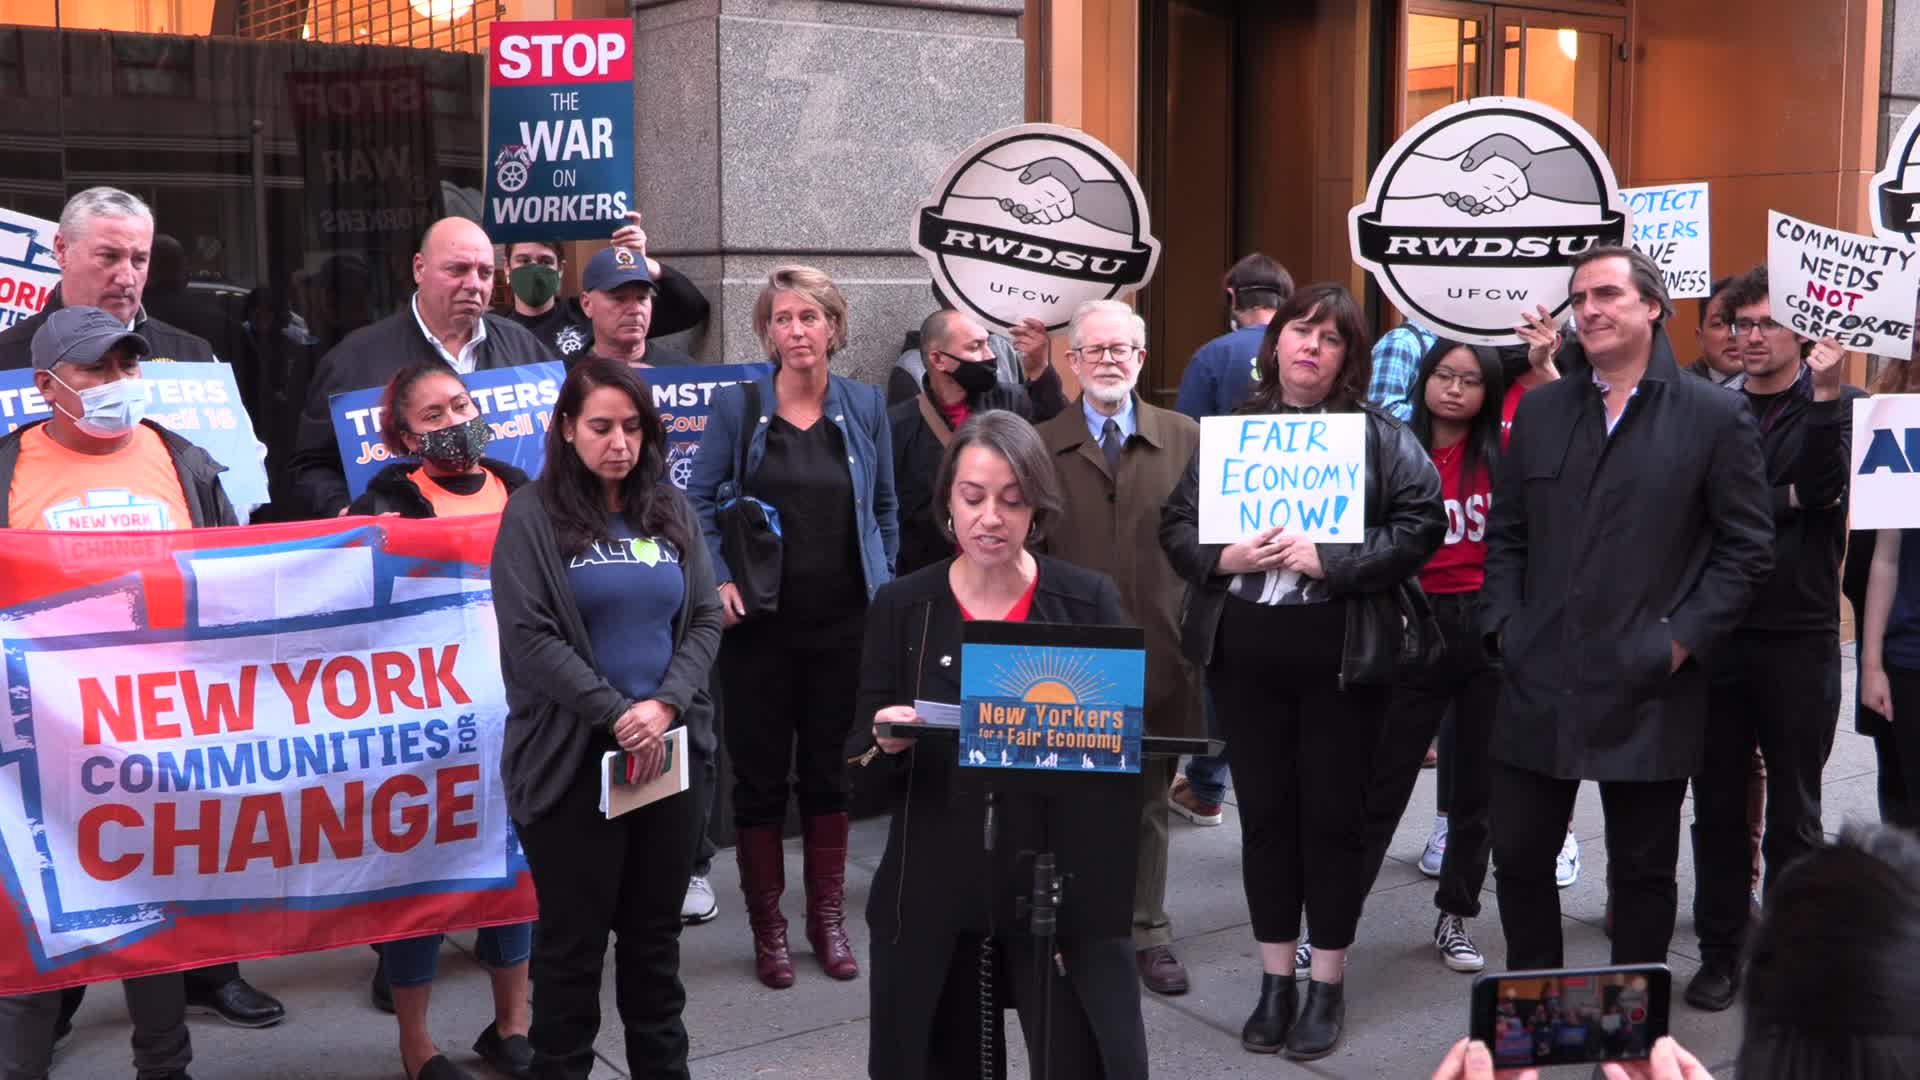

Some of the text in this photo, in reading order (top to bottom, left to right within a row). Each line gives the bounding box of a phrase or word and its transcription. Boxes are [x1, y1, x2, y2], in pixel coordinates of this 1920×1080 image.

[499, 33, 626, 79] STOP
[550, 92, 579, 111] THE
[519, 117, 614, 163] WAR
[552, 169, 577, 188] ON
[492, 190, 627, 224] WORKERS
[1618, 189, 1703, 215] OTECT
[940, 228, 1127, 275] RWDSU
[1384, 235, 1599, 257] RWDSU
[1776, 218, 1916, 272] COMMUNITY
[1800, 252, 1883, 291] NEEDS
[0, 277, 54, 313] ORK
[990, 281, 1060, 304] UFCW
[1447, 287, 1528, 300] UFCW
[1806, 280, 1863, 311] NOT
[1786, 294, 1913, 340] CORPORATE
[1792, 313, 1874, 347] GREED
[1239, 419, 1328, 453] FAIR
[1221, 457, 1359, 496] ECONOMY
[68, 512, 153, 529] NEW YORK
[1240, 495, 1349, 535] NOW!
[78, 644, 473, 745] NEW YORK
[457, 712, 477, 754] FOR
[979, 702, 1026, 725] New
[1035, 703, 1124, 729] Yorkers
[81, 718, 450, 795] COMMUNITIES
[979, 727, 1122, 753] for a Fair Economy
[78, 763, 481, 882] CHANGE
